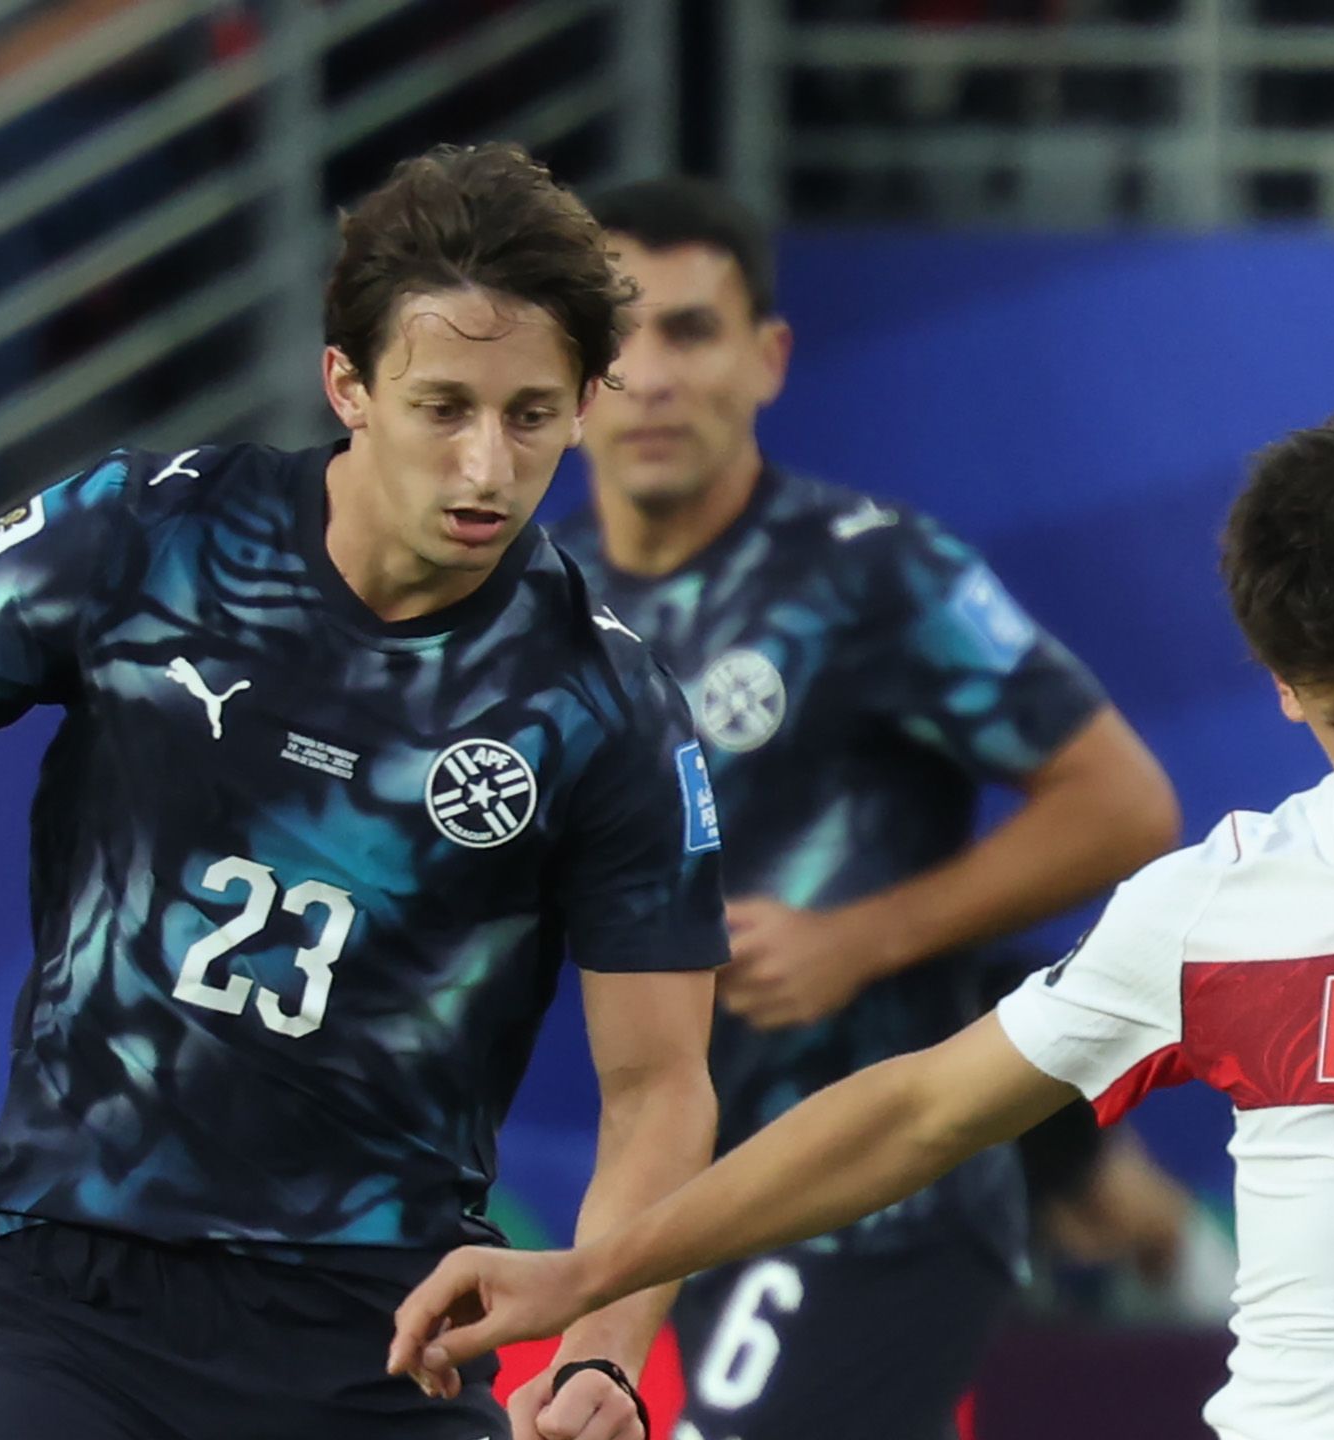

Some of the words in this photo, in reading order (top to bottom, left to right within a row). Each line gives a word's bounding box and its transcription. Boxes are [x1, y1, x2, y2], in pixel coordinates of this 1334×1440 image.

[473, 747, 511, 770] APF
[172, 855, 356, 1039] 23
[697, 1260, 804, 1409] 6
